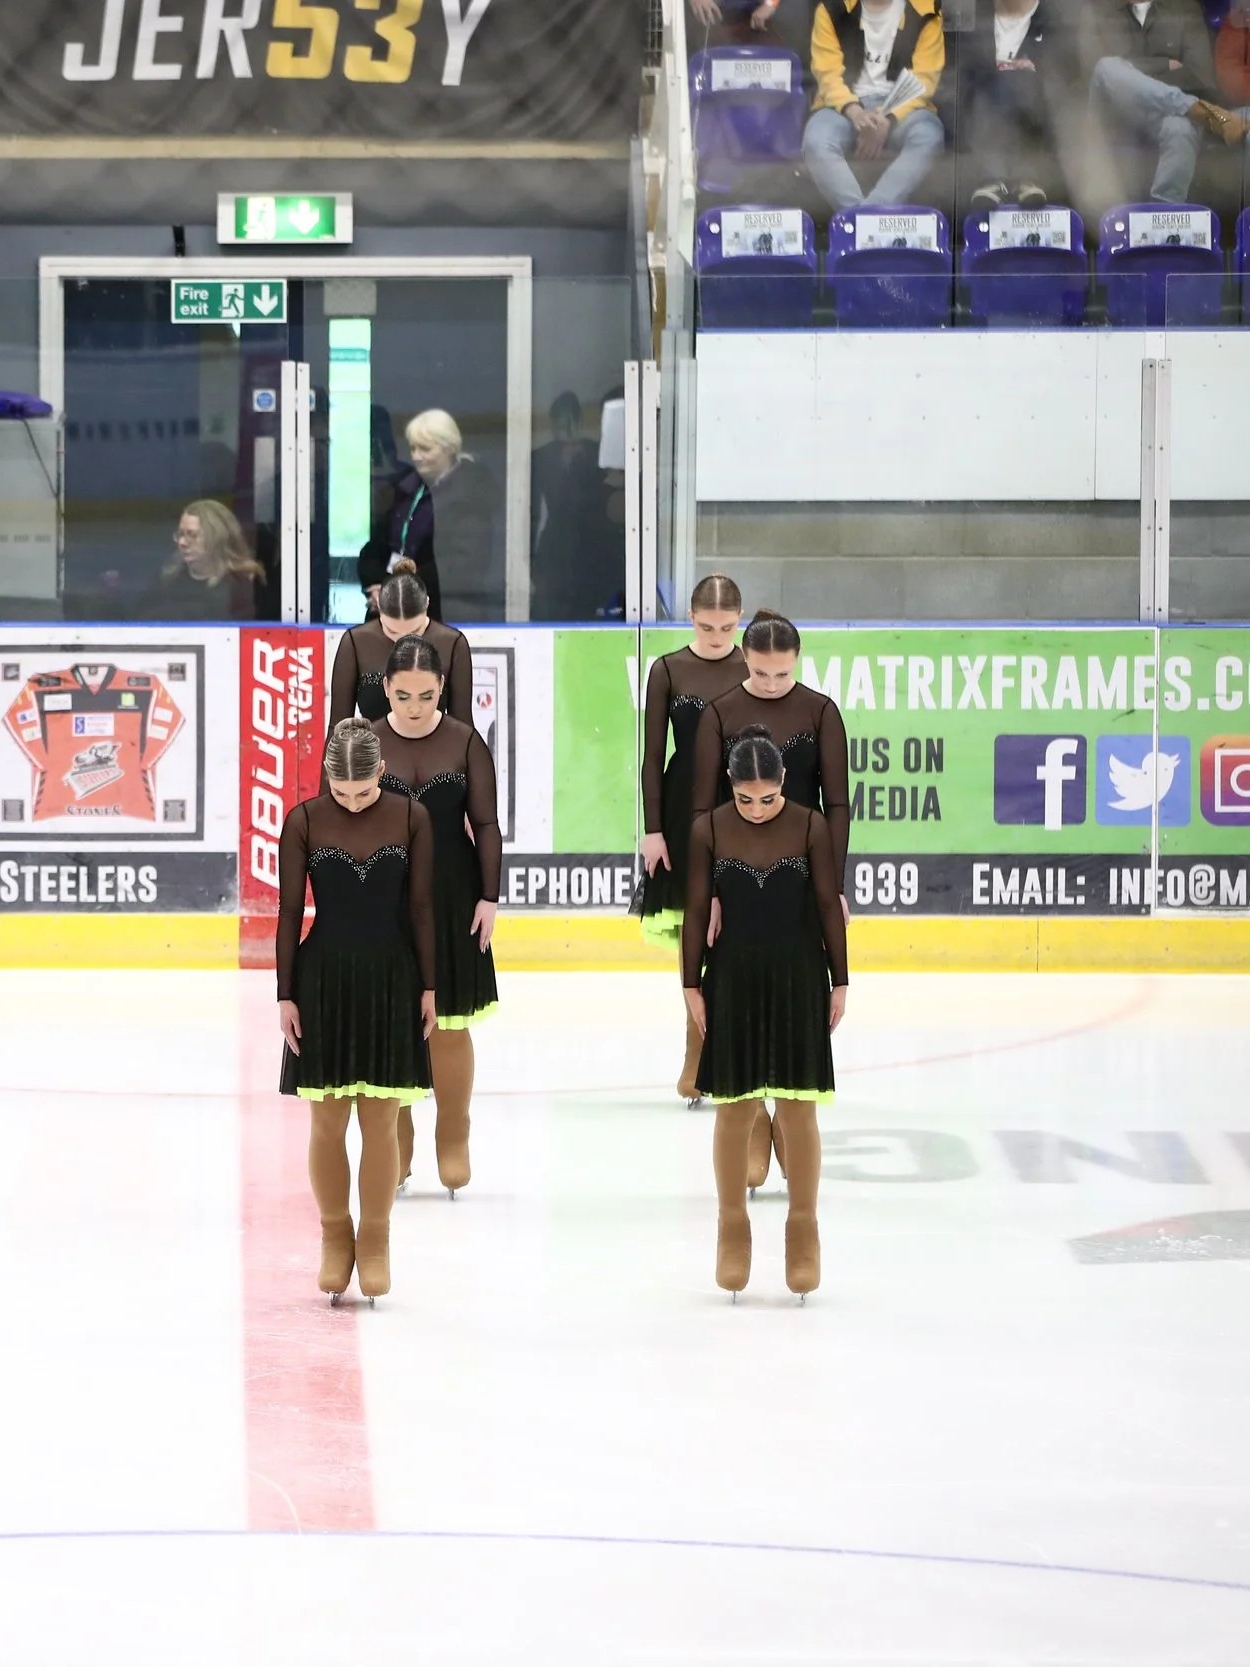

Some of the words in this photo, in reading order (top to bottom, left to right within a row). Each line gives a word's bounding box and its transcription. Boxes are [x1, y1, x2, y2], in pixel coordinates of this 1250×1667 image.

[62, 0, 491, 86] JER53Y
[744, 213, 783, 224] RESERVED
[878, 217, 917, 228] RESERVED
[1012, 213, 1050, 224] RESERVED
[1152, 213, 1191, 224] RESERVED
[180, 287, 209, 300] Fire
[180, 302, 209, 315] exit
[850, 738, 890, 773] US
[903, 738, 944, 773] ON
[0, 860, 158, 903] STEELERS
[498, 867, 632, 905] EPHONE
[855, 862, 919, 905] 939
[972, 863, 1086, 905] EMAIL:
[1109, 863, 1250, 907] INFO@M
